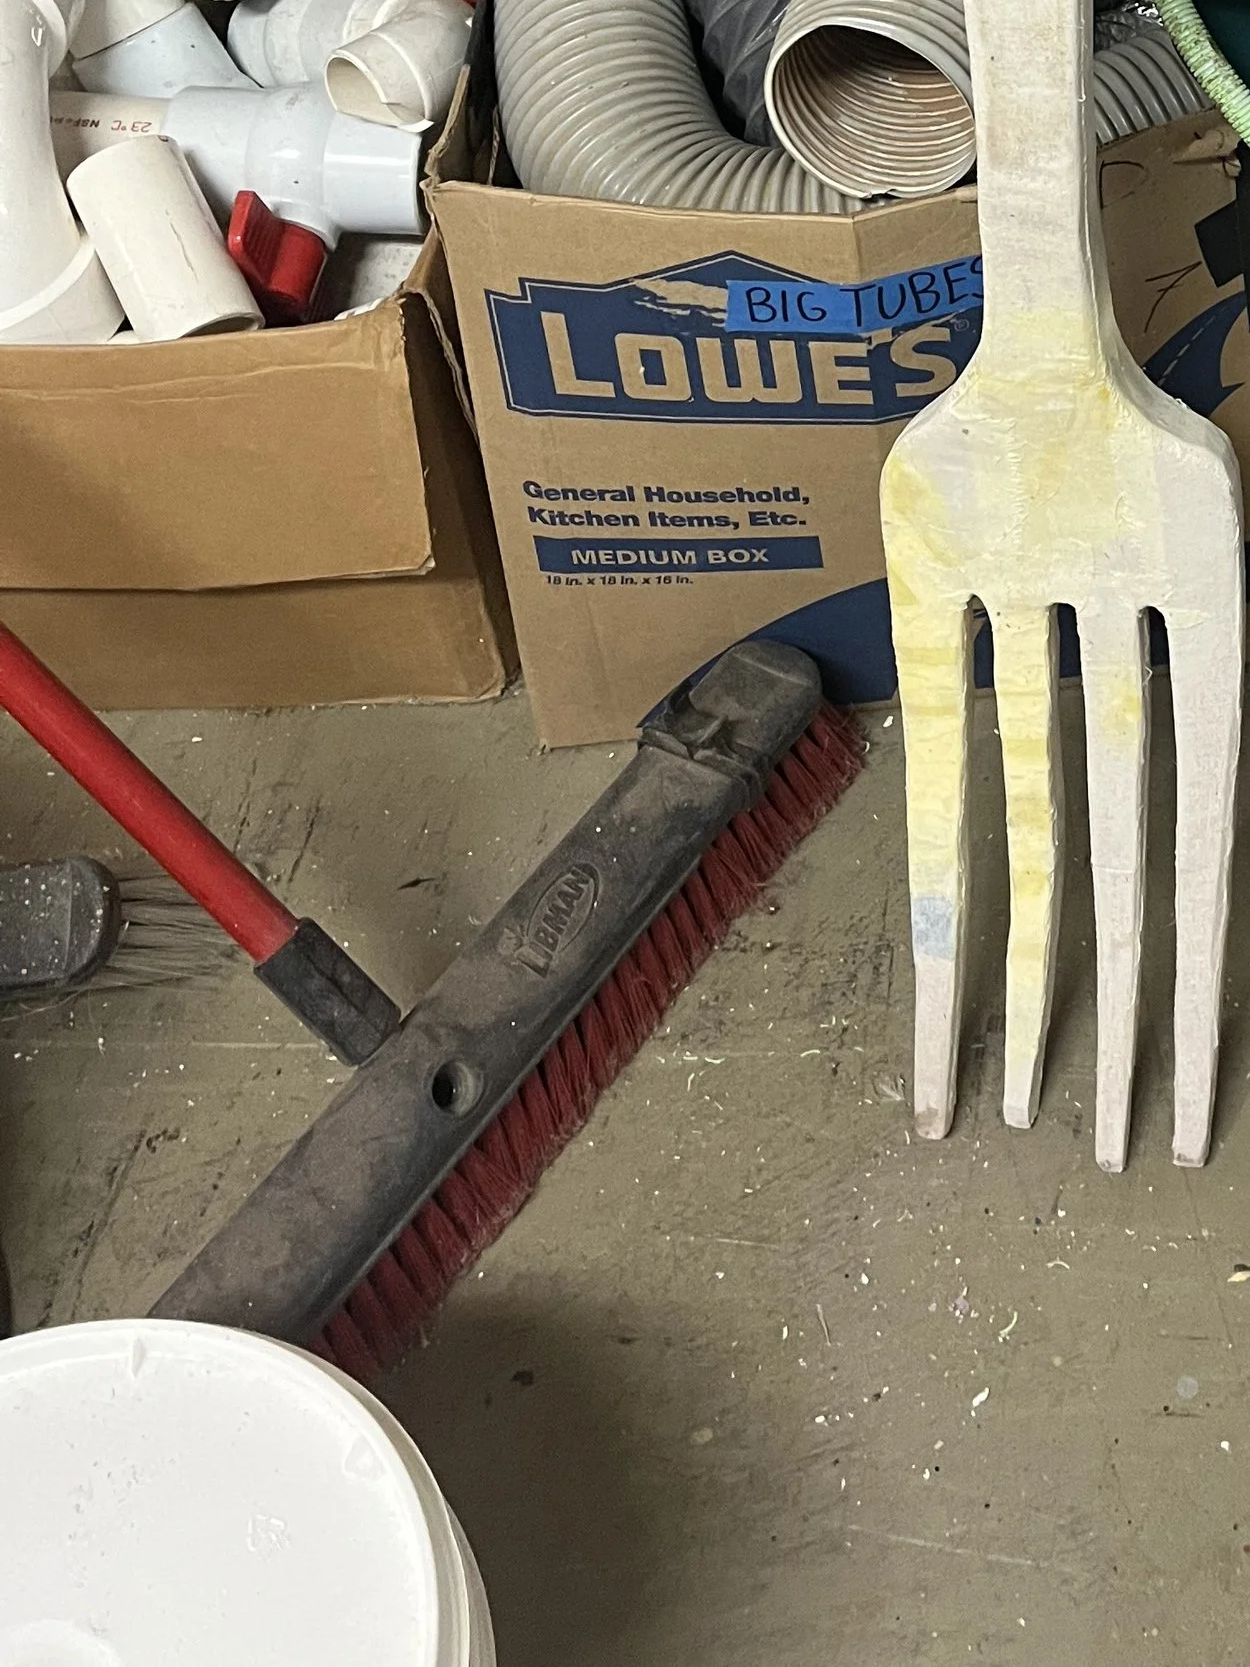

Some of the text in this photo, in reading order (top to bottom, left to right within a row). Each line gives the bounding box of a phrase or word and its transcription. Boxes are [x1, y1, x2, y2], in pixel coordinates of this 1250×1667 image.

[745, 286, 828, 324] BIG
[522, 480, 810, 505] General Household,
[527, 506, 807, 530] Kitchen Items, Etc.
[571, 547, 769, 565] MEDIUM BOX
[546, 575, 561, 585] 18
[600, 576, 617, 585] 18
[655, 575, 672, 585] 16
[517, 867, 590, 977] LIBMAN
